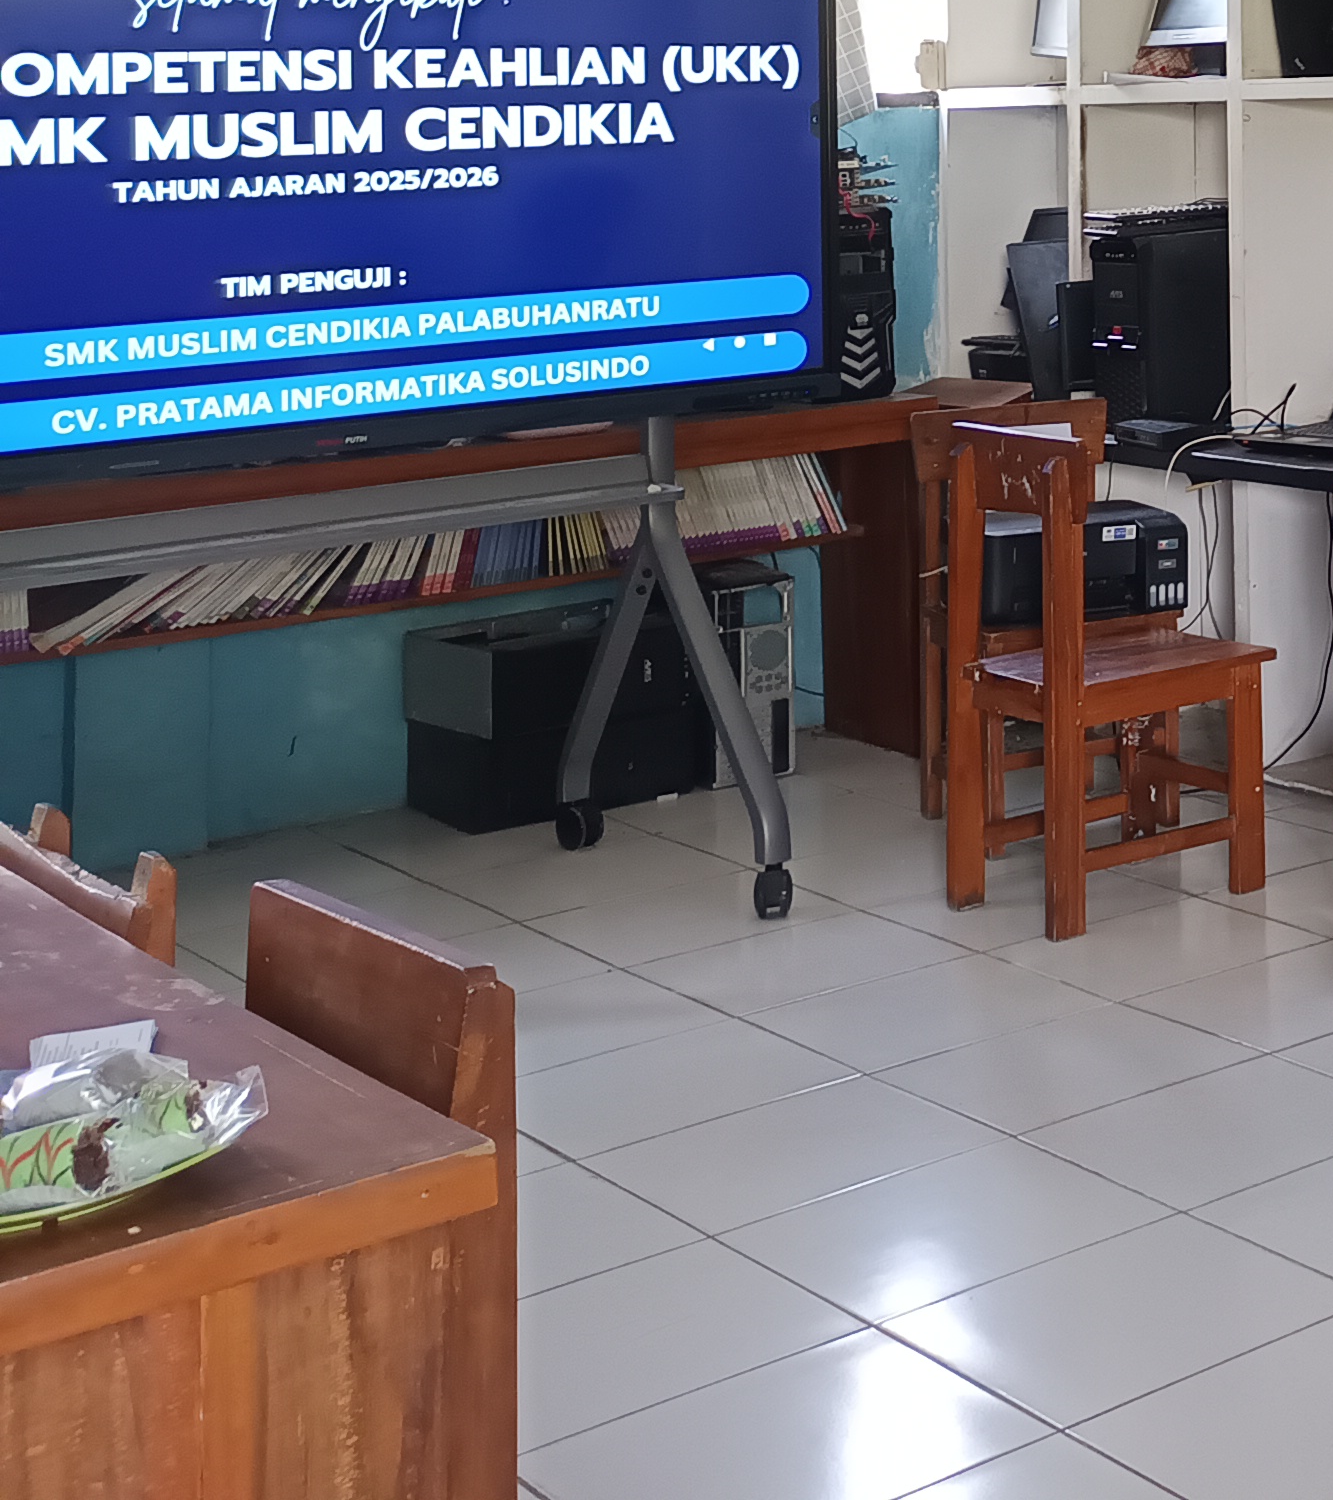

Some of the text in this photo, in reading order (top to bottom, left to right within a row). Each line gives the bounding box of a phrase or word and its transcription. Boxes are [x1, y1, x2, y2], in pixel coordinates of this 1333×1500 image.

[0, 43, 800, 98] OMPETENSI KEAHLIAN (UKK)
[134, 108, 384, 162] MUSLIM
[404, 101, 676, 152] CENDIKIA
[112, 164, 499, 203] TAHUN AJARAN 2025/2026
[220, 273, 272, 298] TIM
[280, 266, 392, 295] PENGUJI
[44, 295, 660, 368] SMK MUSLIM CENDIKIA PALABUHANRATU
[51, 354, 650, 435] CV. PRATAMA INFORMATIKA SOLUSINDO
